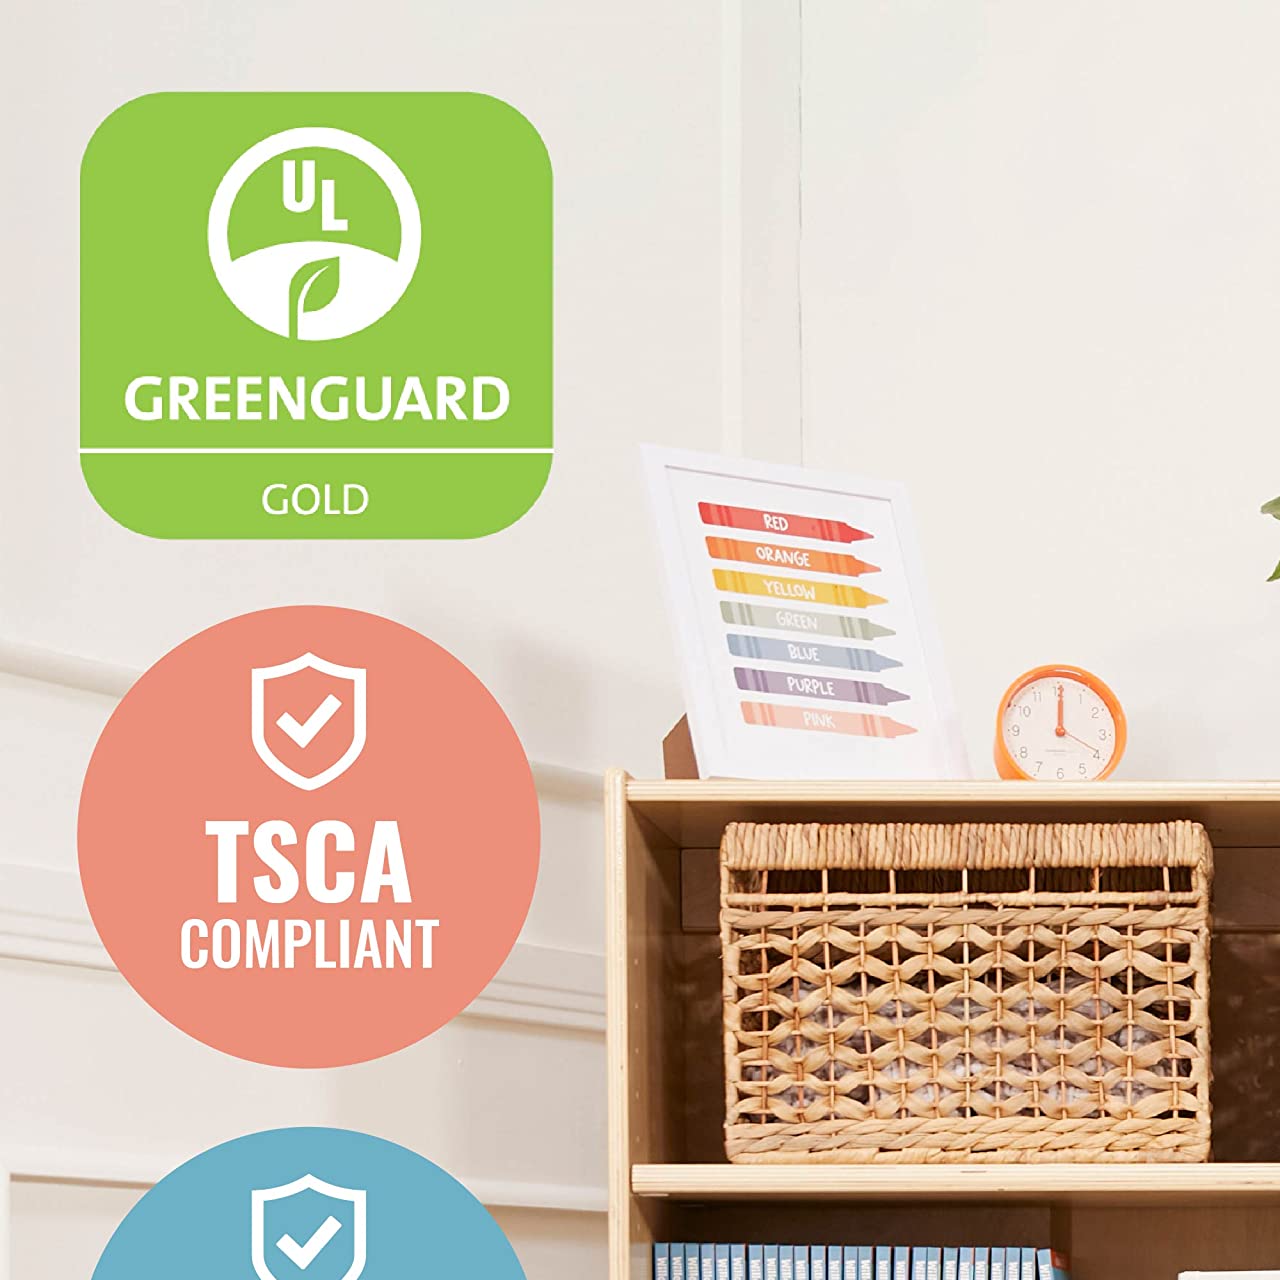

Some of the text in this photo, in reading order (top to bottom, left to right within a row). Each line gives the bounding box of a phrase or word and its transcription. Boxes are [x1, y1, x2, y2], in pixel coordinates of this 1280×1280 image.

[763, 514, 788, 531] RED
[755, 546, 811, 567] ORANGE
[763, 579, 816, 600] YELLOW
[776, 610, 818, 630] GREEN
[787, 644, 821, 661] BLUE
[787, 676, 835, 696] PURPLE
[1033, 691, 1042, 703] 11
[1019, 706, 1031, 718] 10
[1091, 707, 1099, 719] 2
[803, 711, 836, 728] PINK
[1011, 724, 1020, 737] 9
[1098, 729, 1107, 741] 3
[1019, 746, 1028, 759] 8
[1092, 750, 1100, 760] 4
[1035, 761, 1043, 773] 7
[1079, 763, 1087, 775] 5
[1056, 768, 1064, 780] 6
